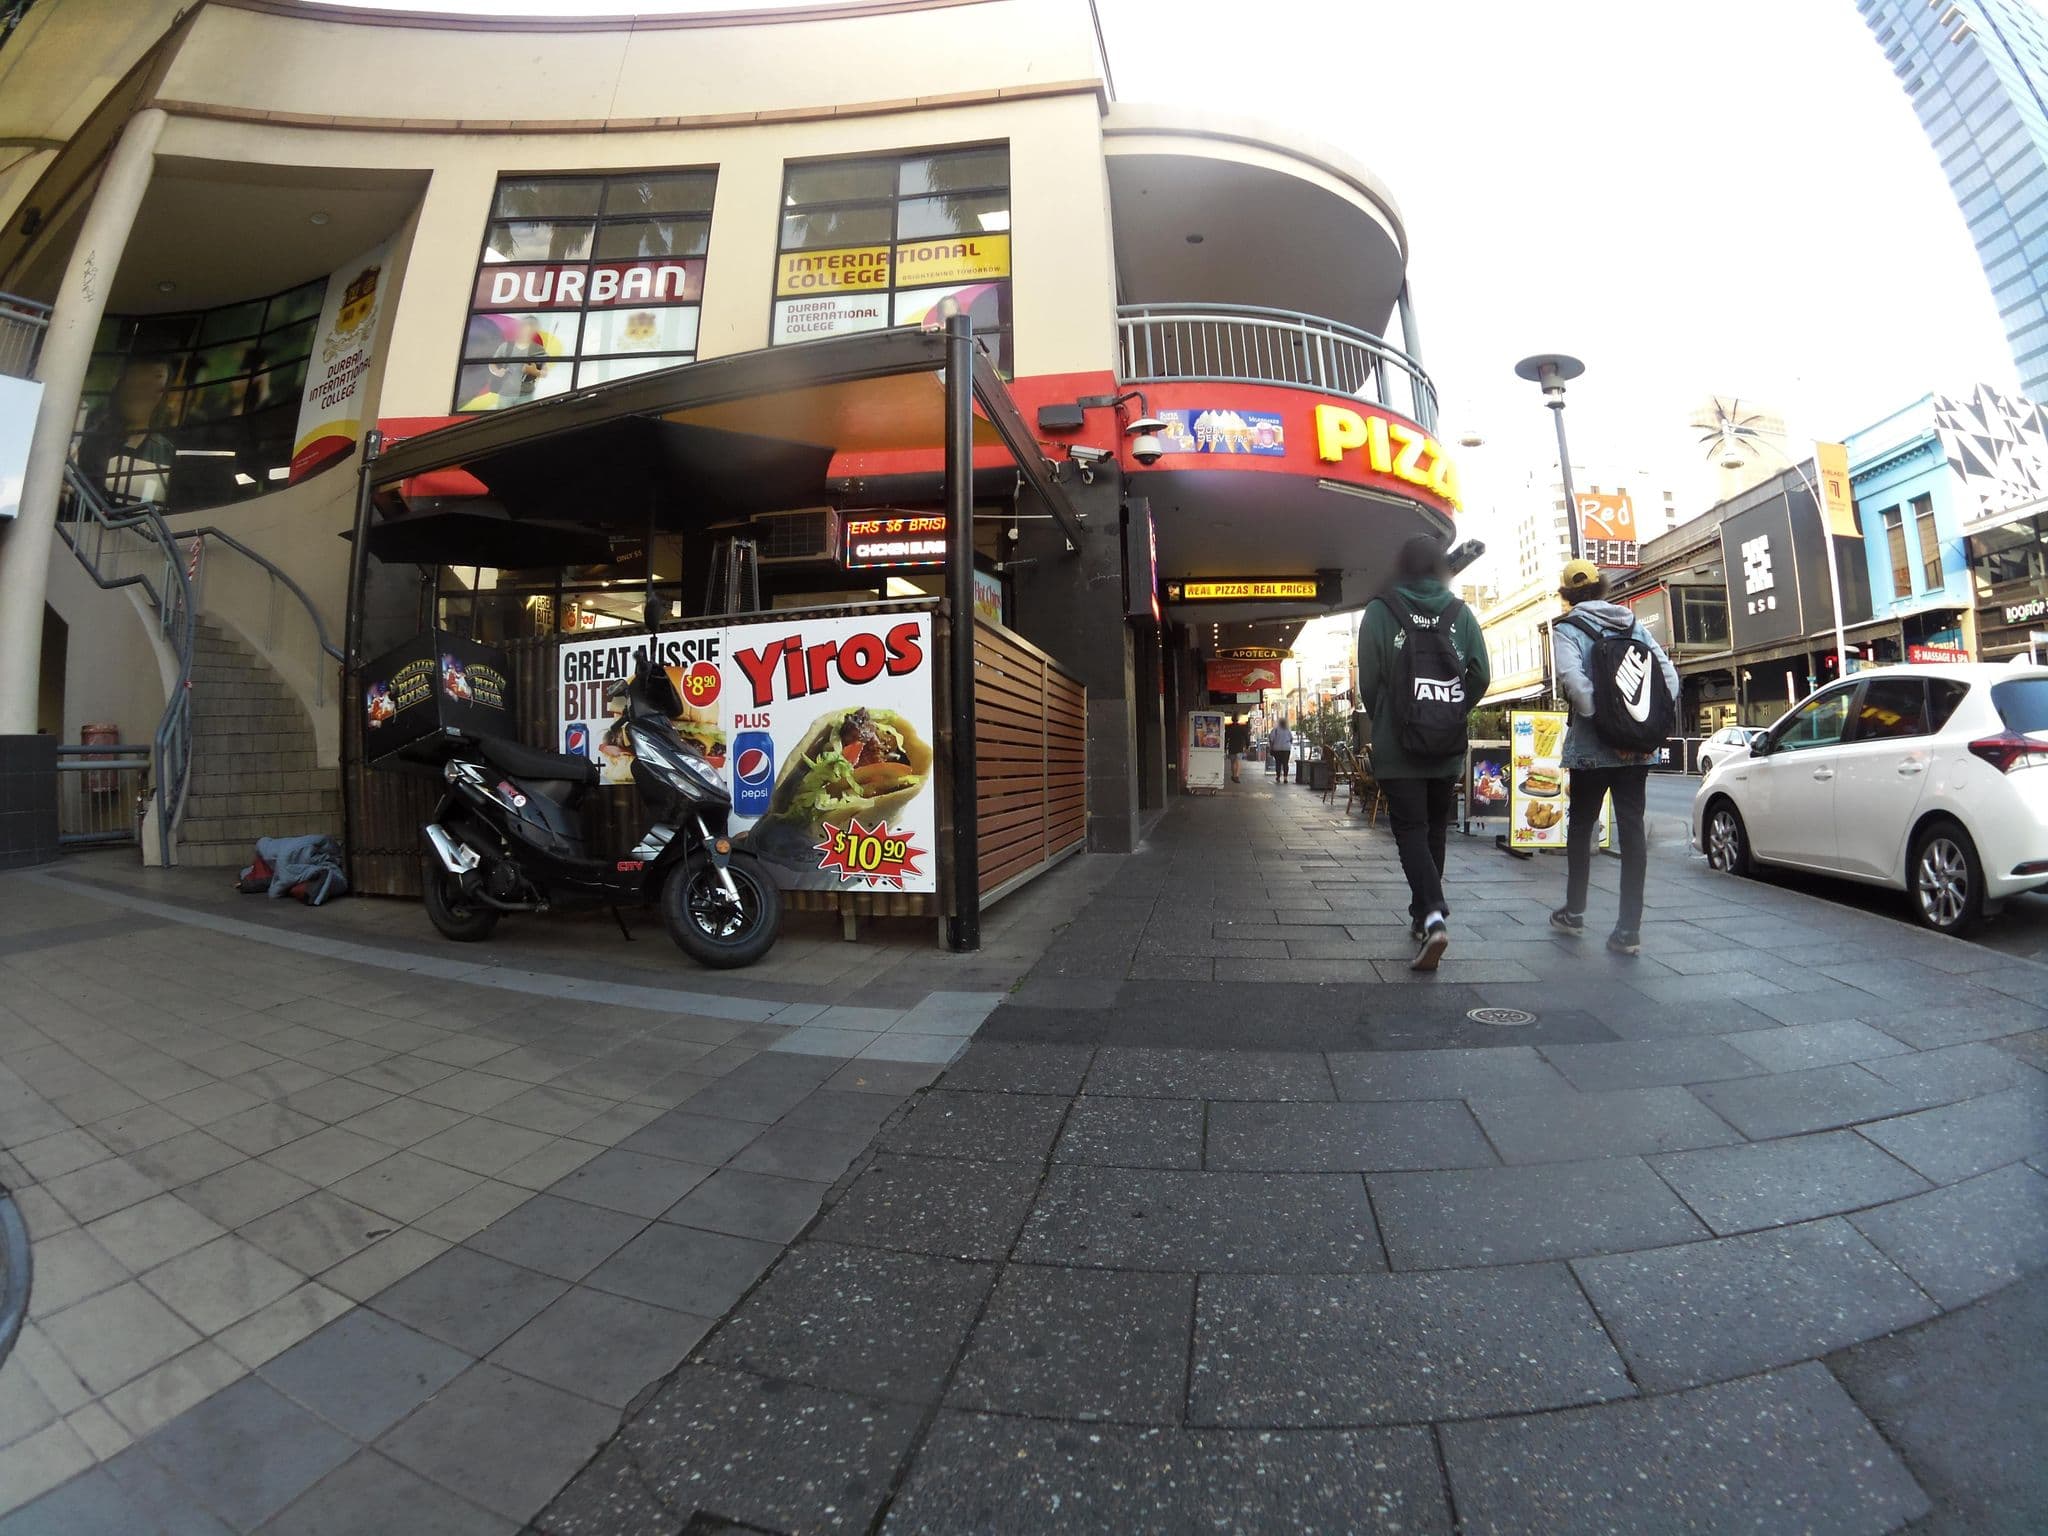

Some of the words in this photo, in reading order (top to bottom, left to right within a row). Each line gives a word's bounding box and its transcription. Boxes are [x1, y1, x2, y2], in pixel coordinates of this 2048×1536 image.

[788, 242, 982, 272] INTERNATIONAL
[490, 265, 687, 304] DURBAN
[787, 268, 887, 289] COLLEGE
[786, 308, 879, 324] INTERNATIONAL
[787, 302, 836, 314] DURBAN
[786, 321, 835, 334] COLLEGE
[326, 349, 364, 379] DURBAN
[308, 355, 372, 402] INTERNATIONAL
[320, 380, 358, 410] COLLEGE
[886, 519, 903, 532] $6
[1580, 498, 1631, 537] Red
[856, 542, 909, 557] CHICKEN
[1187, 585, 1211, 595] REAL
[1215, 584, 1249, 594] PIZZAS
[1254, 584, 1277, 594] REAL
[1280, 583, 1314, 593] PRICES
[564, 646, 631, 683] GREAT
[732, 622, 923, 708] Yiros
[1232, 650, 1278, 659] APOTECA
[1922, 650, 1950, 662] MASSAGE
[1957, 653, 1968, 663] SPA
[398, 673, 429, 695] PIZZA
[474, 677, 500, 692] PIZZA
[1615, 645, 1648, 703] NIKE
[397, 683, 431, 708] HOUSE
[473, 687, 504, 707] HOUSE
[564, 680, 616, 721] BITE
[734, 712, 771, 729] PLUS
[741, 787, 768, 802] pepsi
